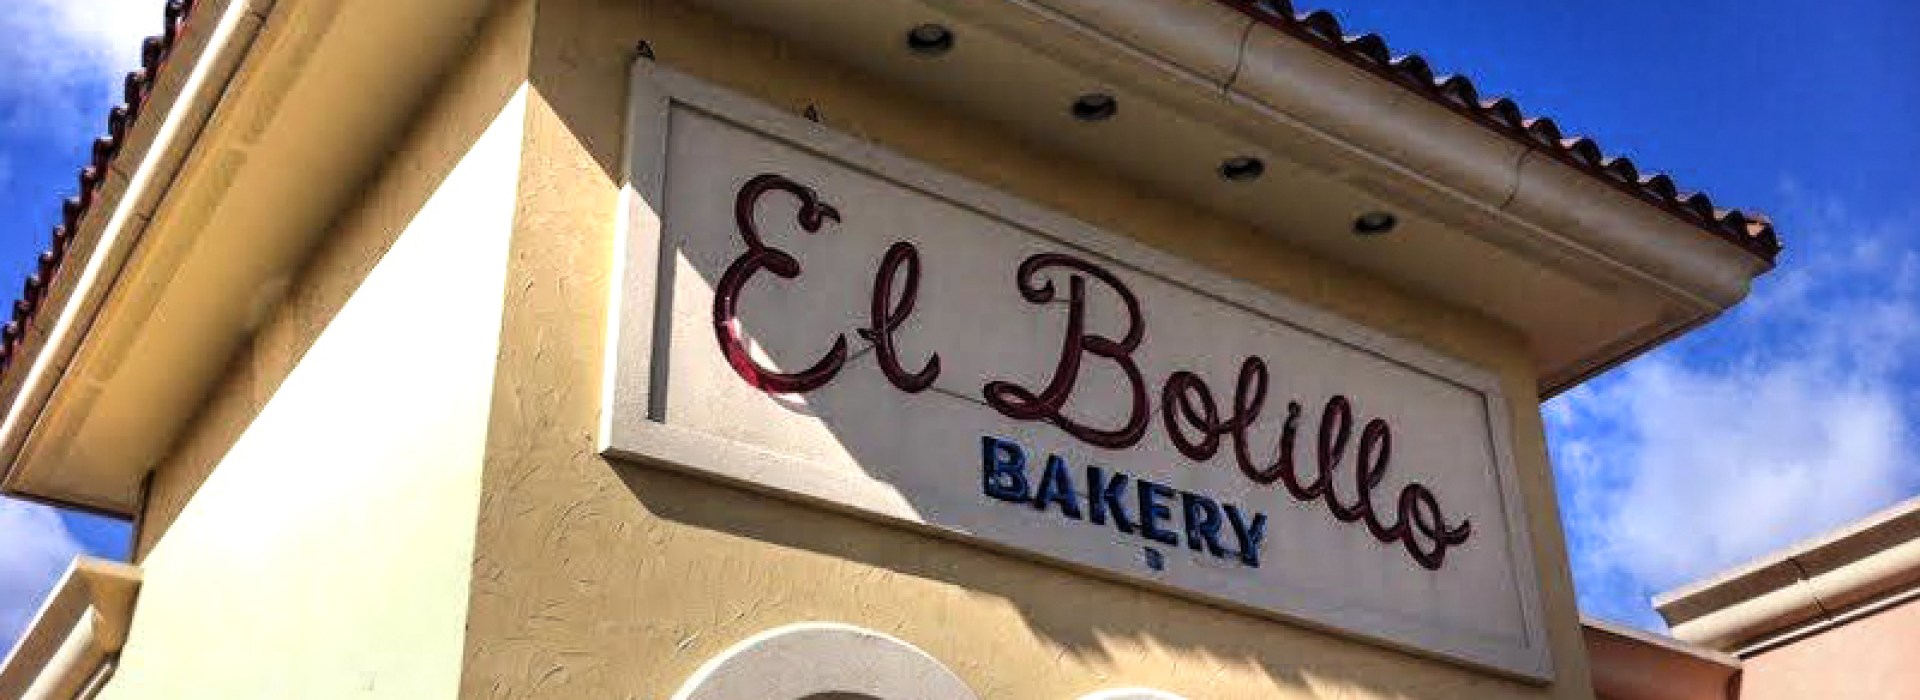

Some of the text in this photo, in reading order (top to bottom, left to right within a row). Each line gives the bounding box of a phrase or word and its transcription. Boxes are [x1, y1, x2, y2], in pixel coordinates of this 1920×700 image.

[713, 174, 1470, 571] El Bolillo
[981, 436, 1268, 568] BAKERY
